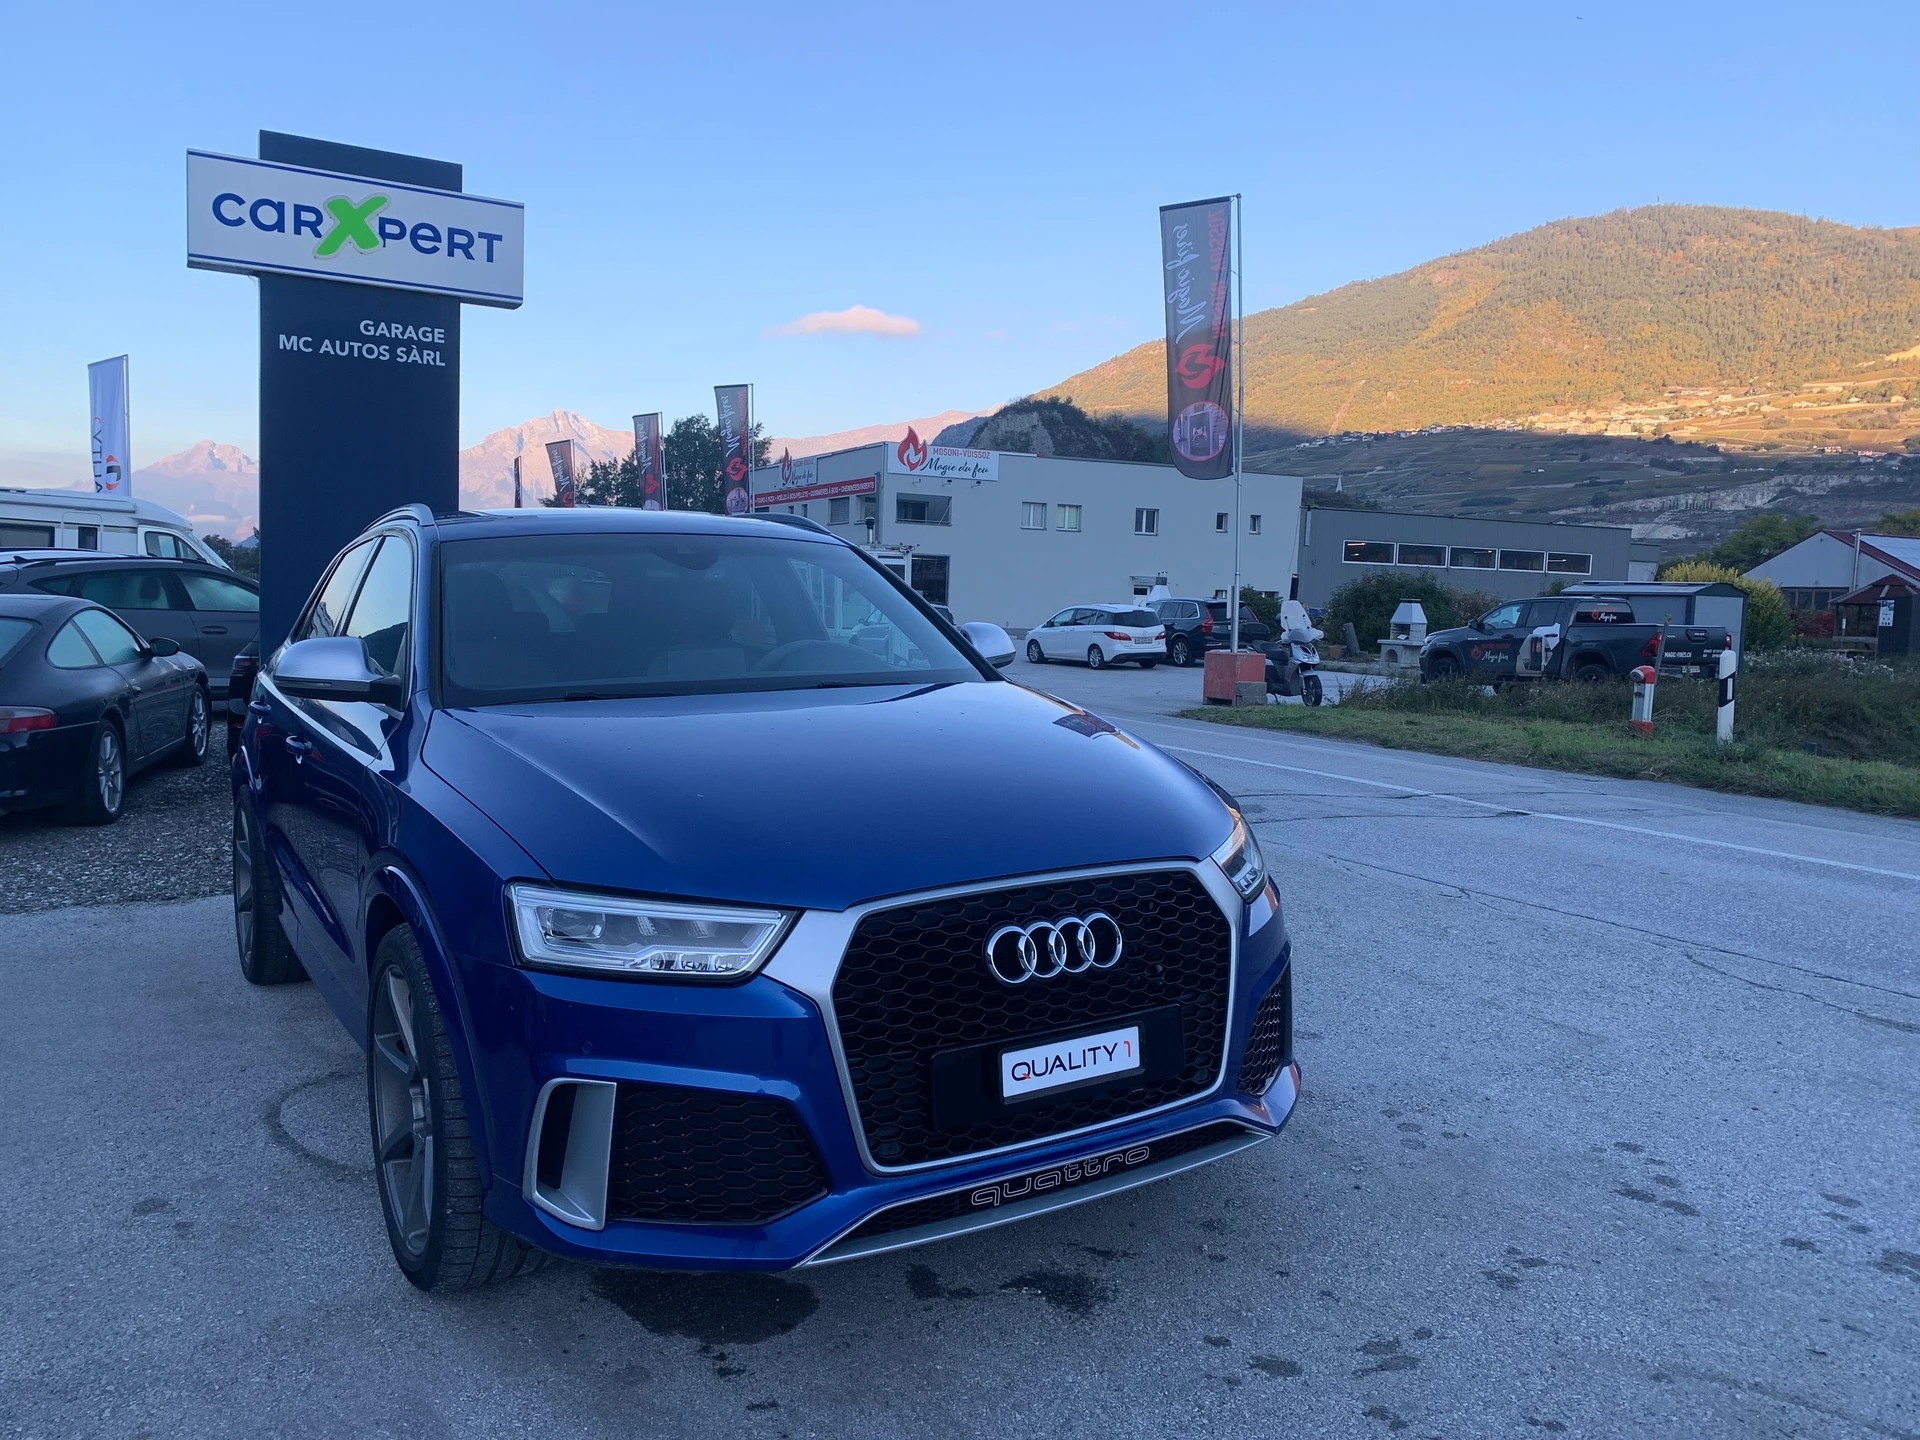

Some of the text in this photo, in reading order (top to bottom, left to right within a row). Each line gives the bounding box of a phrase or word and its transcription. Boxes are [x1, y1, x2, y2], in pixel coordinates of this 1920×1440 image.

[360, 319, 445, 344] GARAGE
[279, 334, 446, 367] MC AUTOS SÀRL
[932, 447, 991, 460] MOSONI-VUISSOZ
[920, 458, 990, 478] Magie du feu
[971, 1146, 1150, 1207] quattro
